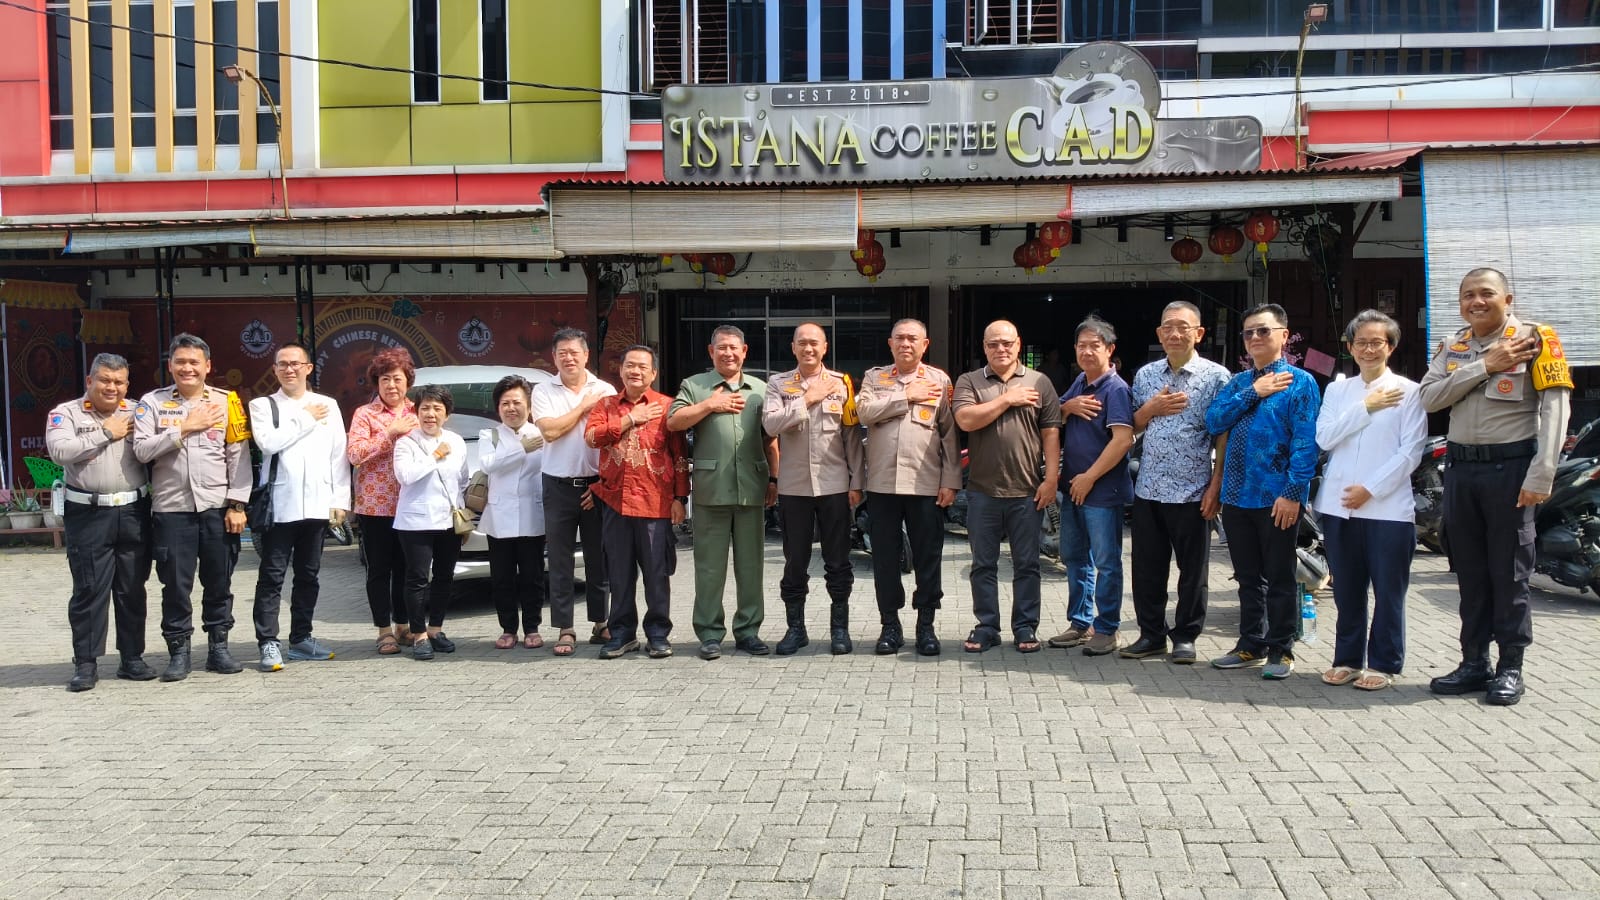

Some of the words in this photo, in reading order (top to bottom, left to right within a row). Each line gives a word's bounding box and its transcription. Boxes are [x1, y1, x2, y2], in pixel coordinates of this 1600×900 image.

[799, 89, 833, 102] EST
[850, 86, 899, 101] 2018
[669, 114, 868, 168] ISTANA
[870, 120, 998, 154] COFFEE
[1005, 104, 1155, 165] C.A.D
[332, 330, 378, 349] CHINESE
